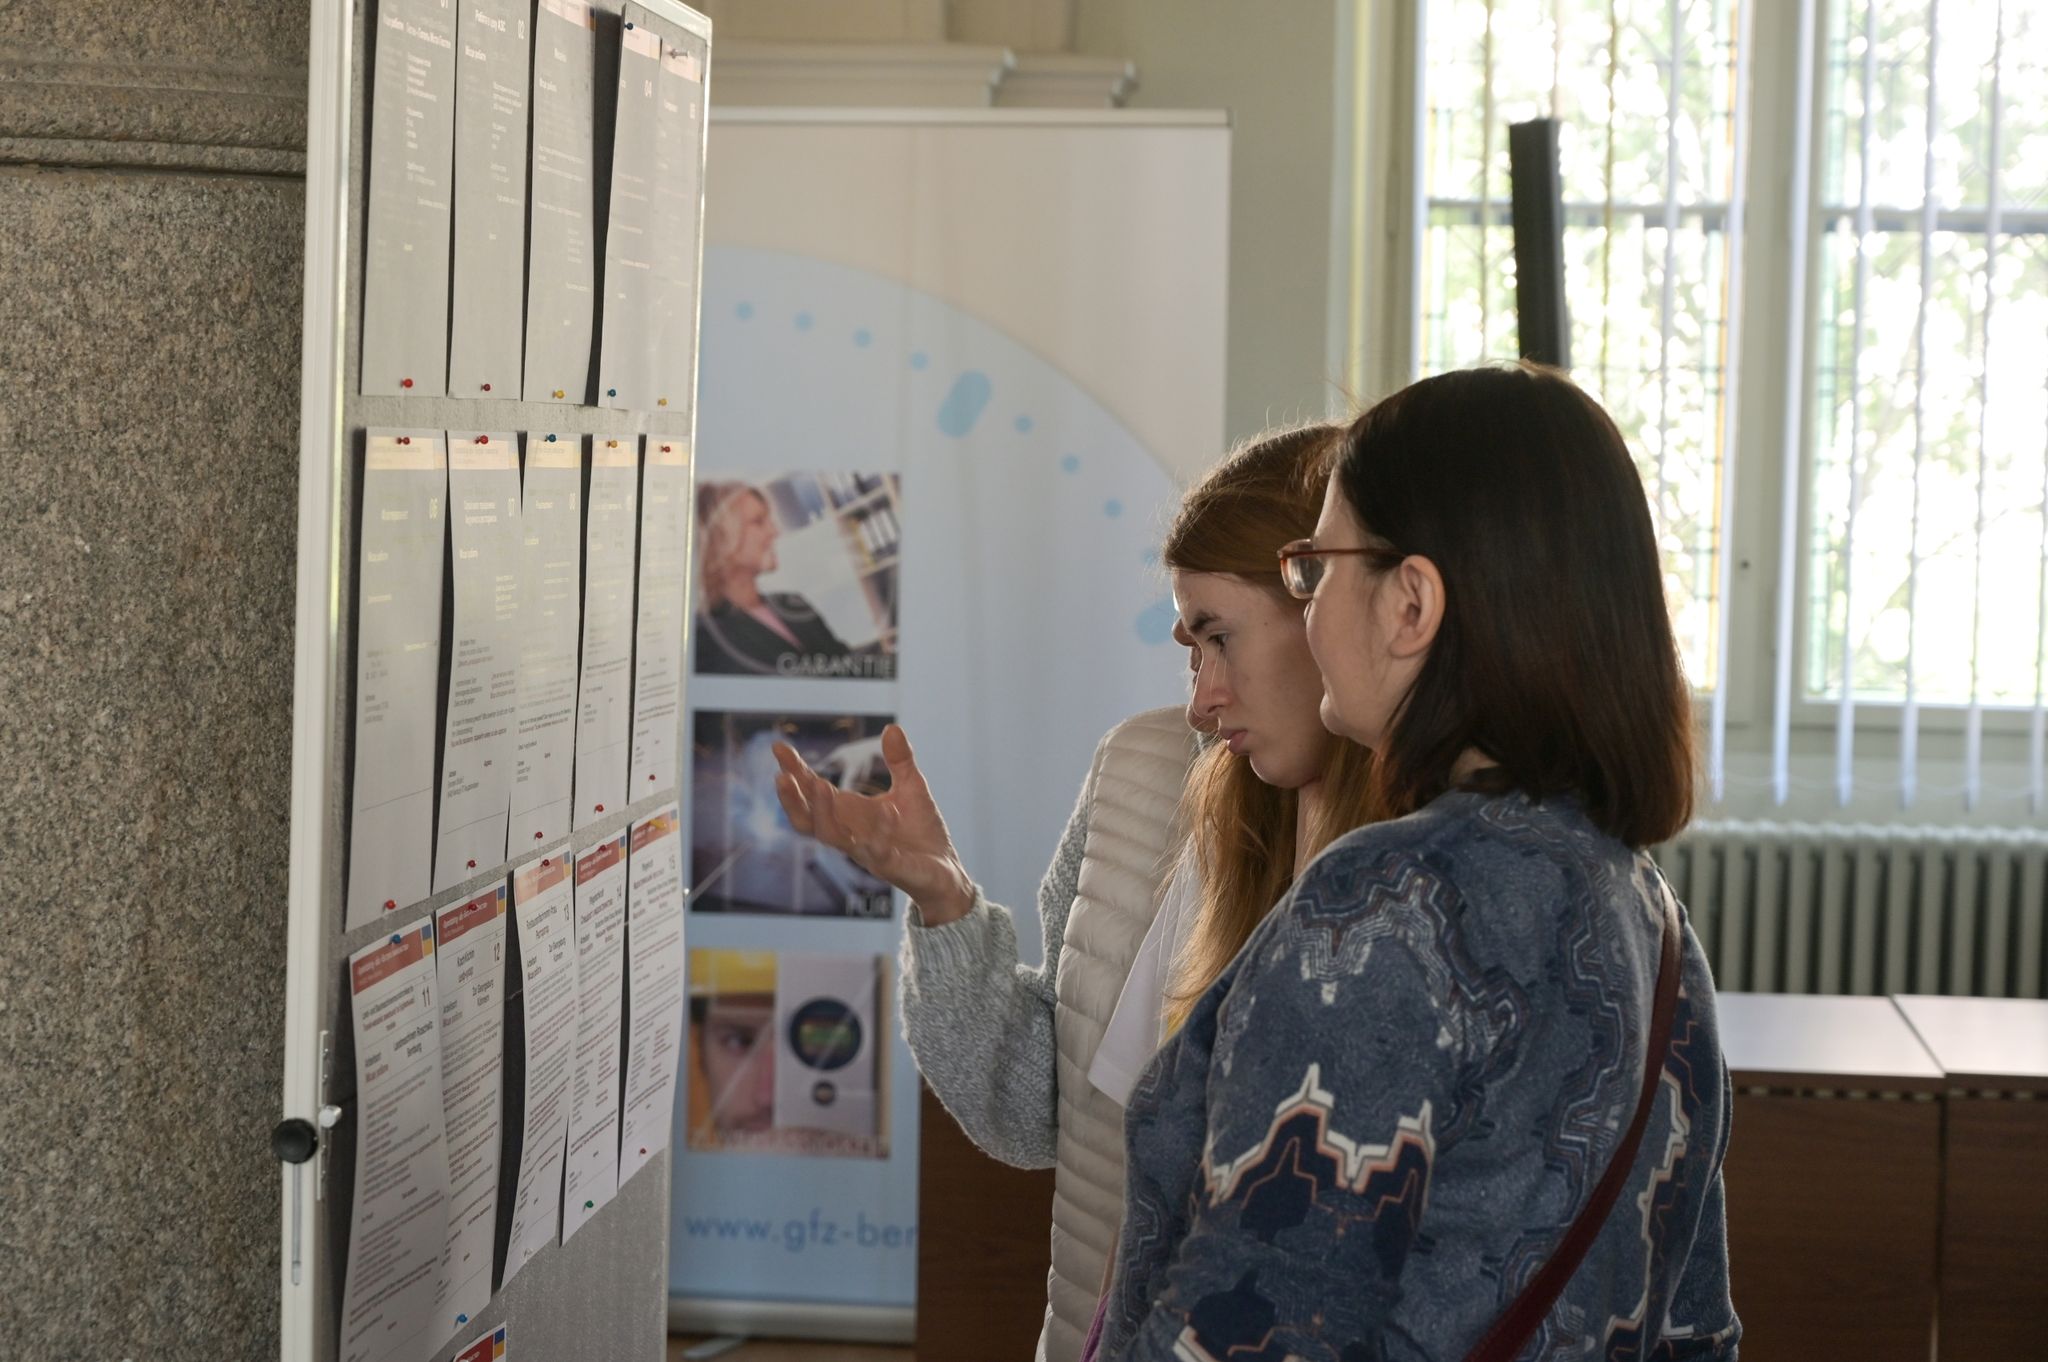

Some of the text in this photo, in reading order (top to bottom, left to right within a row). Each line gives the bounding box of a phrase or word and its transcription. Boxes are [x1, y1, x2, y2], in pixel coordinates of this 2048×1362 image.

[776, 652, 895, 679] GARANTIE
[494, 942, 500, 962] 12
[422, 985, 431, 1008] 11
